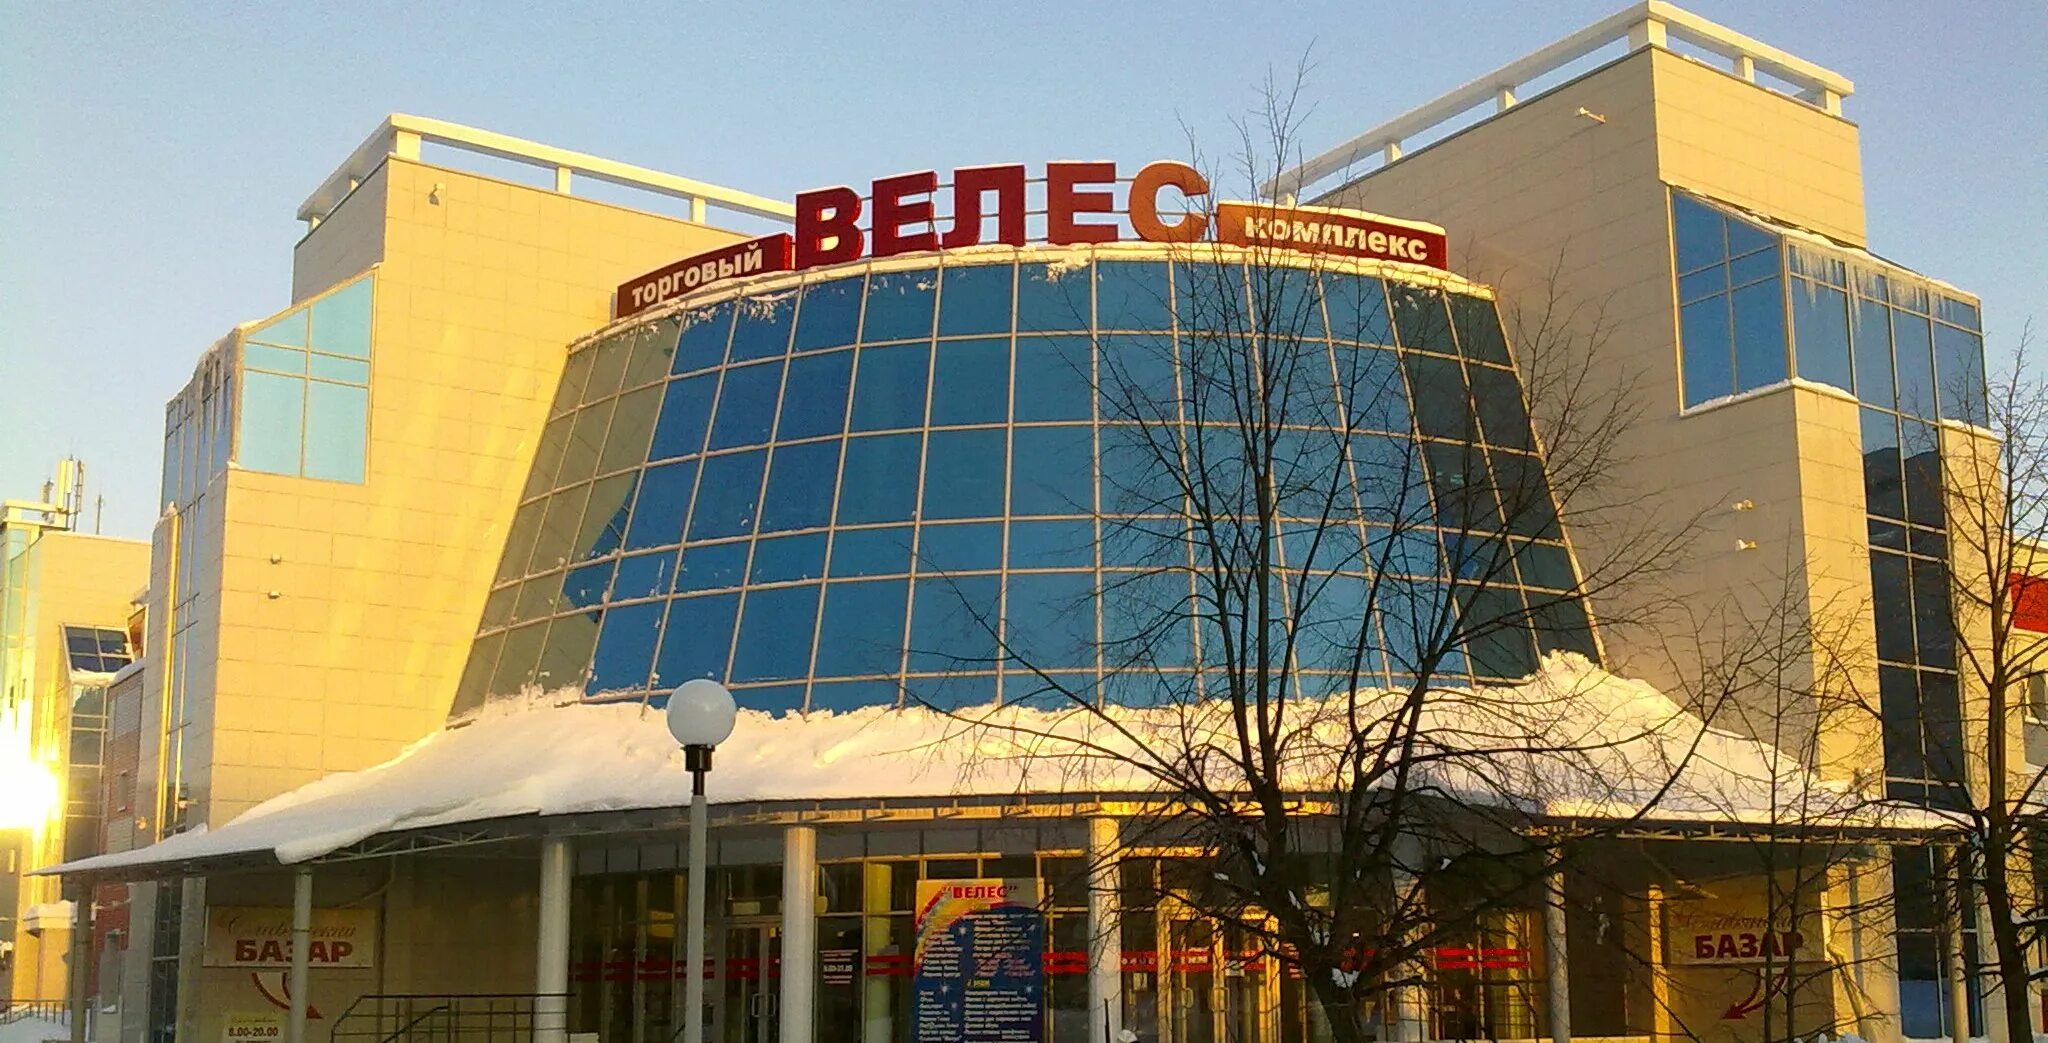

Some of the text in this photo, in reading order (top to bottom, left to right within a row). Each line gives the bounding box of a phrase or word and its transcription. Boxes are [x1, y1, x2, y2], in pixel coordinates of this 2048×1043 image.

[796, 160, 1210, 271] ВЕЛЕС
[1244, 216, 1428, 261] комплекс
[632, 242, 763, 303] торговый
[1695, 933, 1804, 959] БАЗАР
[228, 1027, 279, 1037] 8.00-20.00
